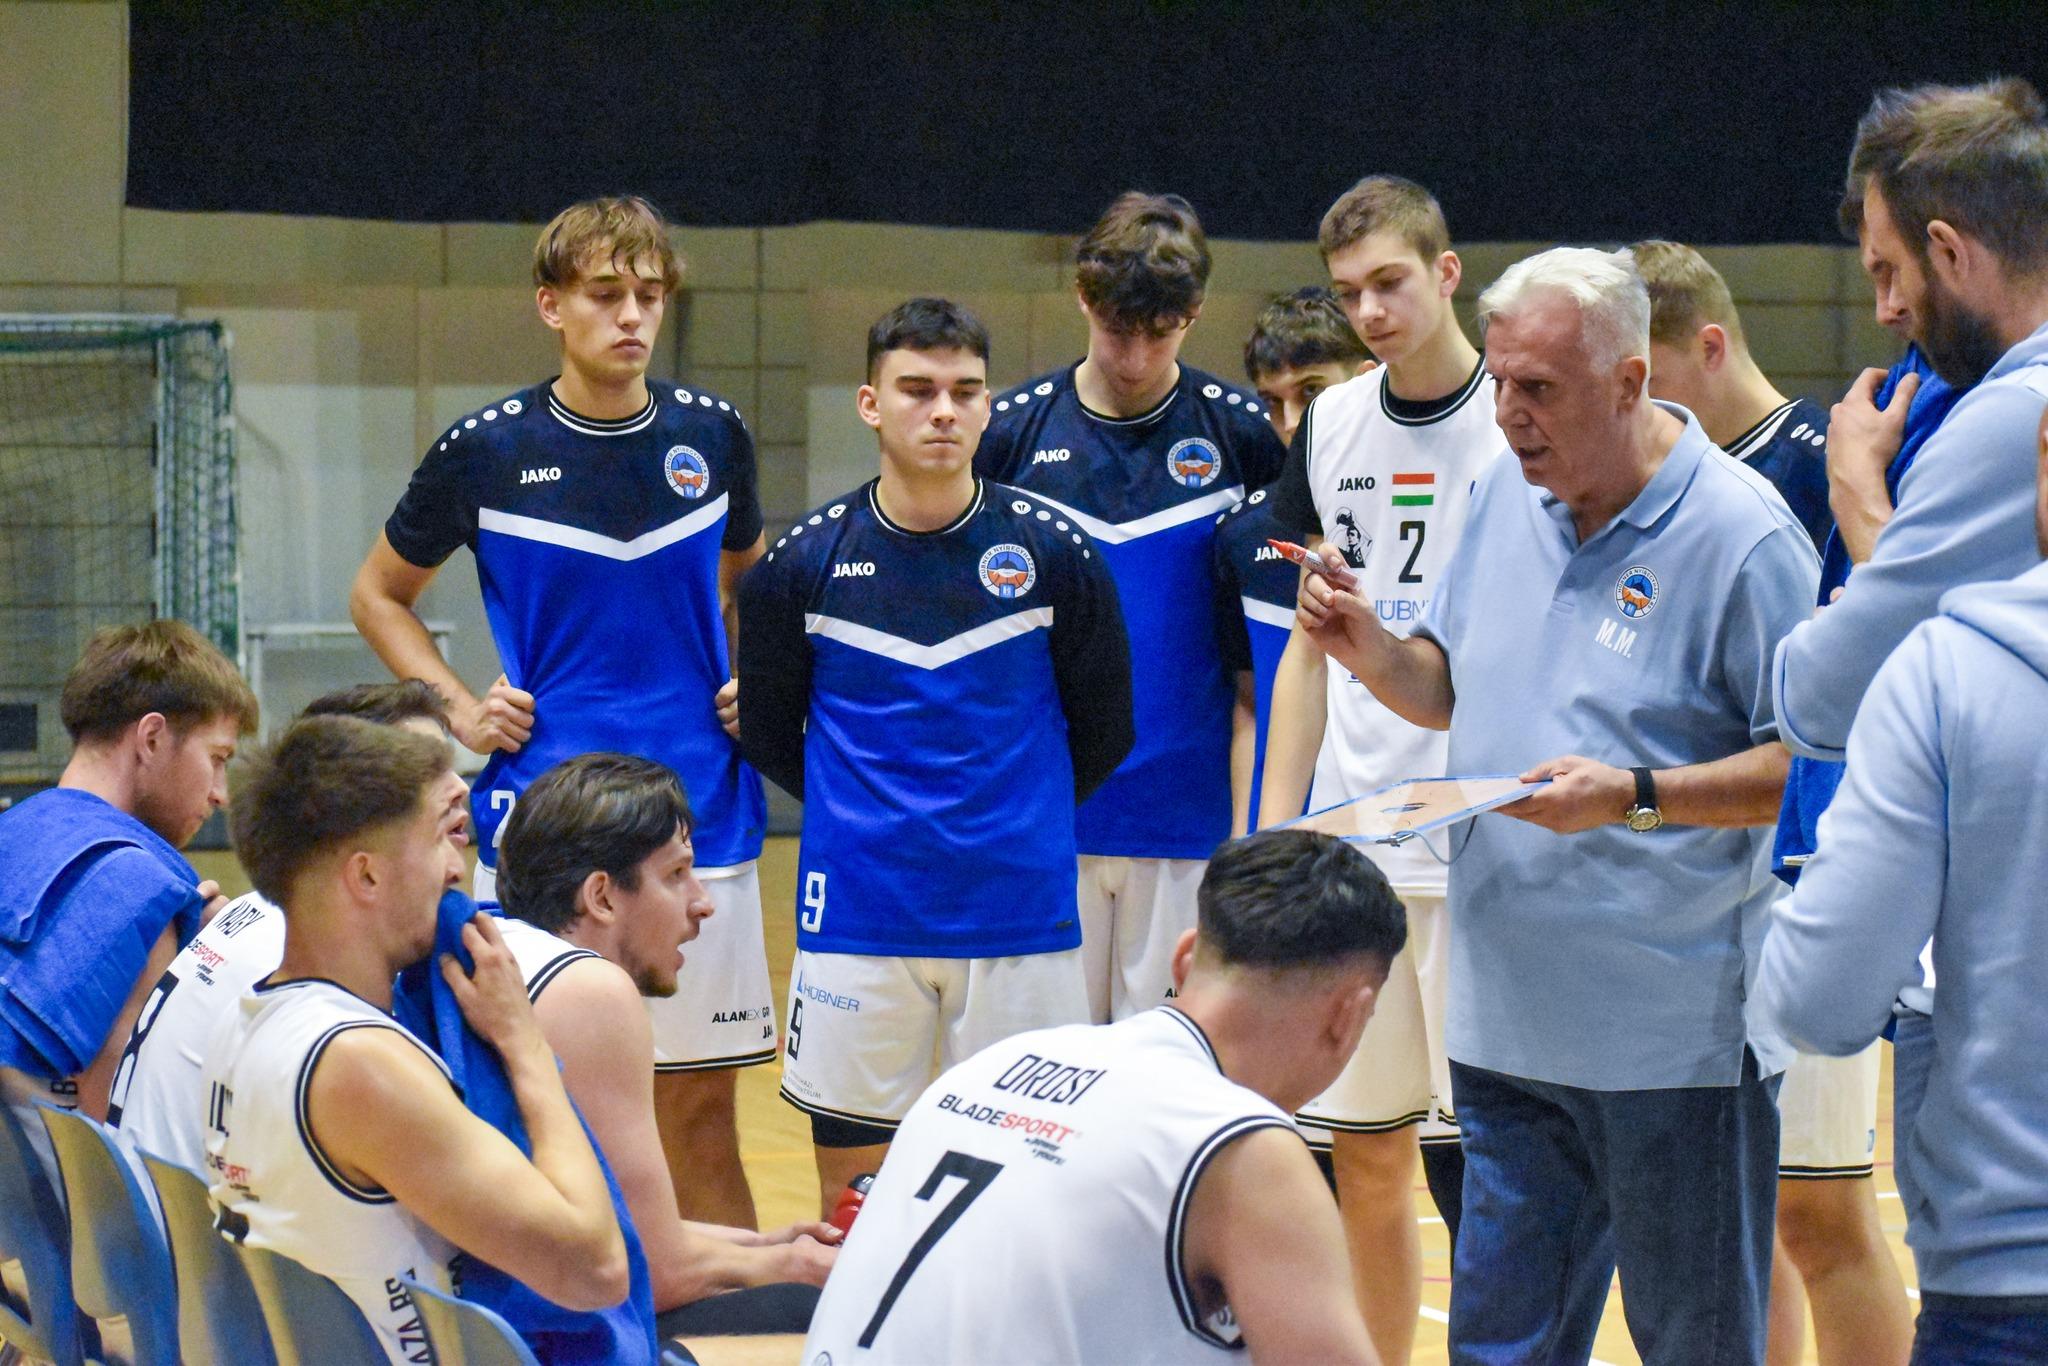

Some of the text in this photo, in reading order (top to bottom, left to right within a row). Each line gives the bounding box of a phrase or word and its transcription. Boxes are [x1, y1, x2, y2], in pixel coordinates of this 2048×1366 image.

[1031, 448, 1071, 465] JAKO
[519, 466, 562, 485] JAKO
[1337, 476, 1375, 492] JAKO
[1254, 546, 1284, 561] JAK
[1398, 520, 1426, 583] 2
[831, 561, 876, 579] JAKO
[801, 871, 827, 933] 9
[213, 900, 266, 938] NAGY
[712, 1008, 760, 1024] ALANEX
[993, 1053, 1108, 1106] OROSI
[937, 1094, 1075, 1143] BLADESPORT
[857, 1149, 1005, 1350] 7
